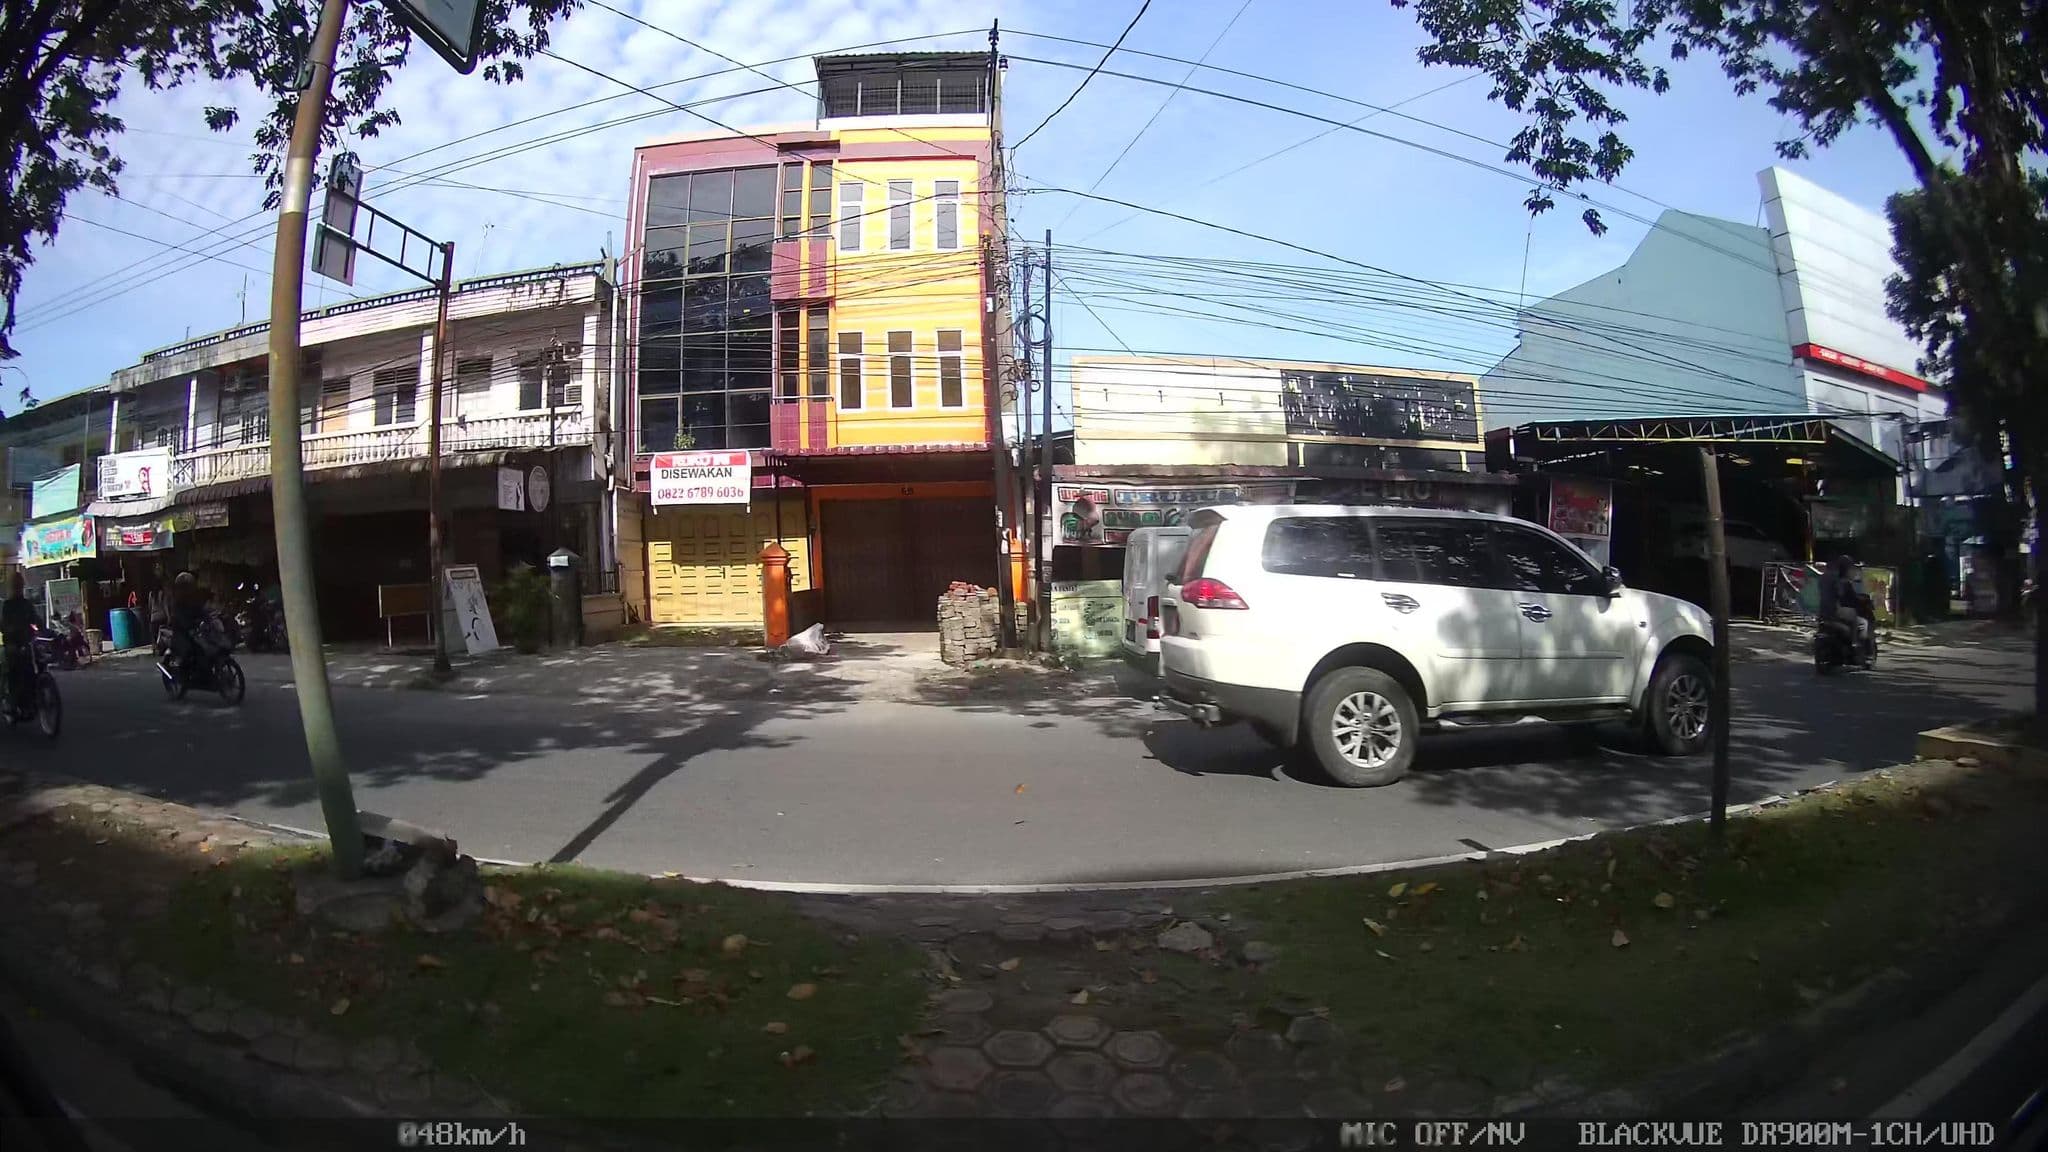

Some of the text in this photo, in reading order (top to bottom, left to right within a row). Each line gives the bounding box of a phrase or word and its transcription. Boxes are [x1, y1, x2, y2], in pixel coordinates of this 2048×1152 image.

[661, 467, 732, 479] DISEWAKAN
[657, 486, 744, 499] 0822 6789 6036
